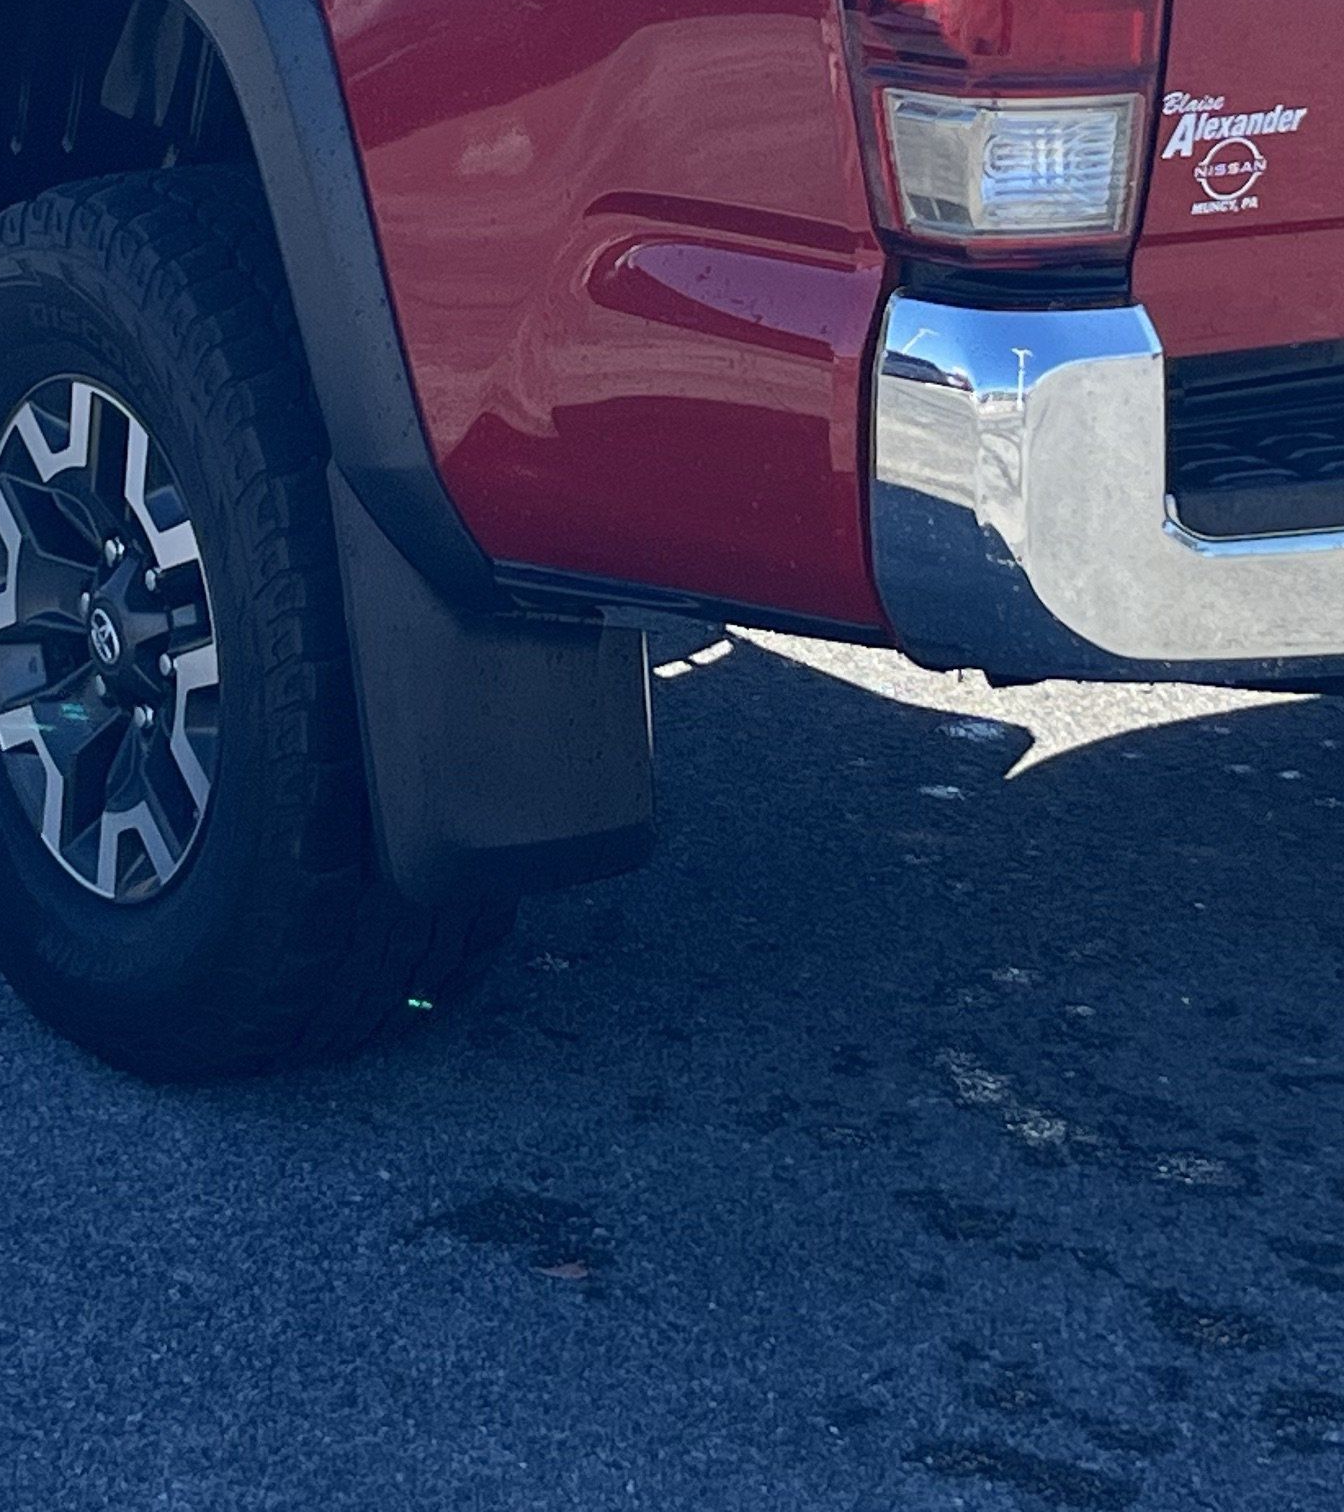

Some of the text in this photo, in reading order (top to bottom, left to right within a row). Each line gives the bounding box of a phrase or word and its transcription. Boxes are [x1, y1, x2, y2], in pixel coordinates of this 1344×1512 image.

[1162, 92, 1225, 115] Blaise
[1161, 104, 1307, 159] Alexander
[1194, 159, 1267, 178] NISSAN
